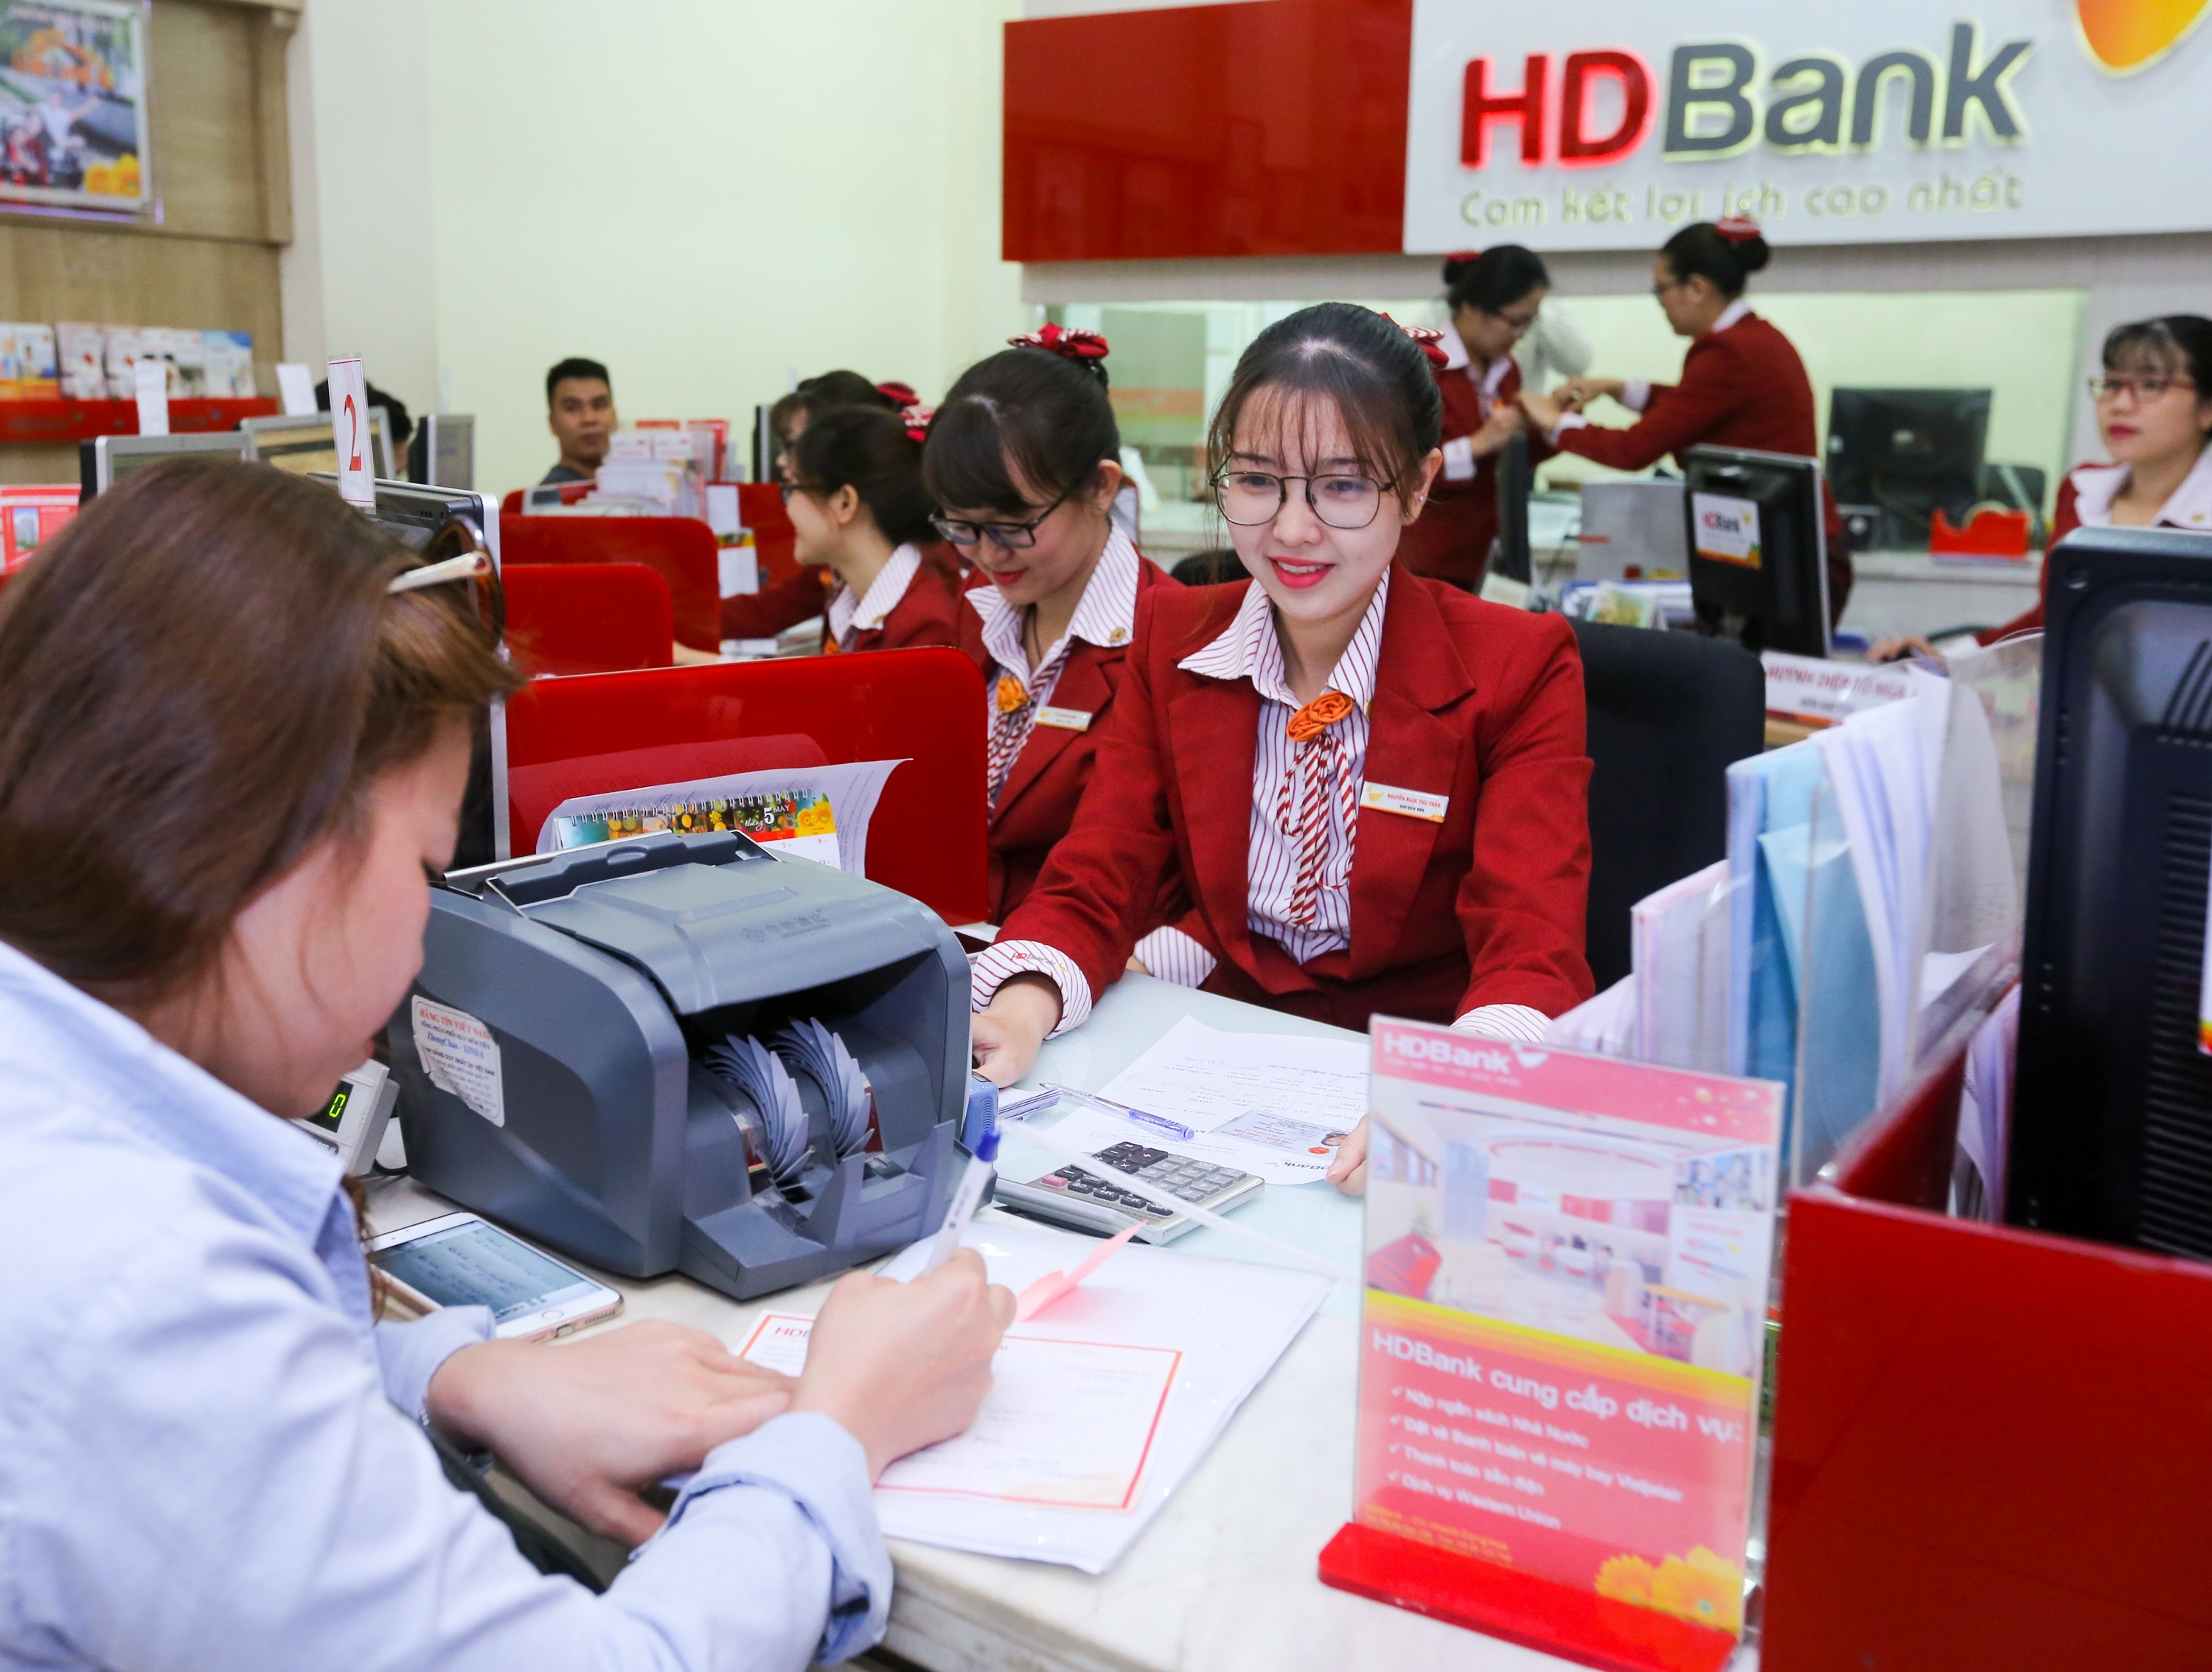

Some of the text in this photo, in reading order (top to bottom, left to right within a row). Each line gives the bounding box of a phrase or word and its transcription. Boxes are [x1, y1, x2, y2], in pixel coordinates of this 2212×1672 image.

[1461, 20, 2033, 169] HDBank
[1804, 183, 1890, 216] cao
[344, 394, 362, 471] 2
[763, 807, 775, 825] 5
[773, 805, 790, 814] MAY
[1387, 794, 1405, 802] NGUYỄN
[1428, 800, 1441, 808] THẢO
[1383, 1033, 1510, 1074] HDBank
[329, 1093, 347, 1118] 0
[1372, 1328, 1483, 1384] HDBank
[1489, 1367, 1559, 1410] cung
[1565, 1383, 1619, 1420] cấp
[1626, 1398, 1688, 1431] dịch
[1517, 1504, 1562, 1530] Union
